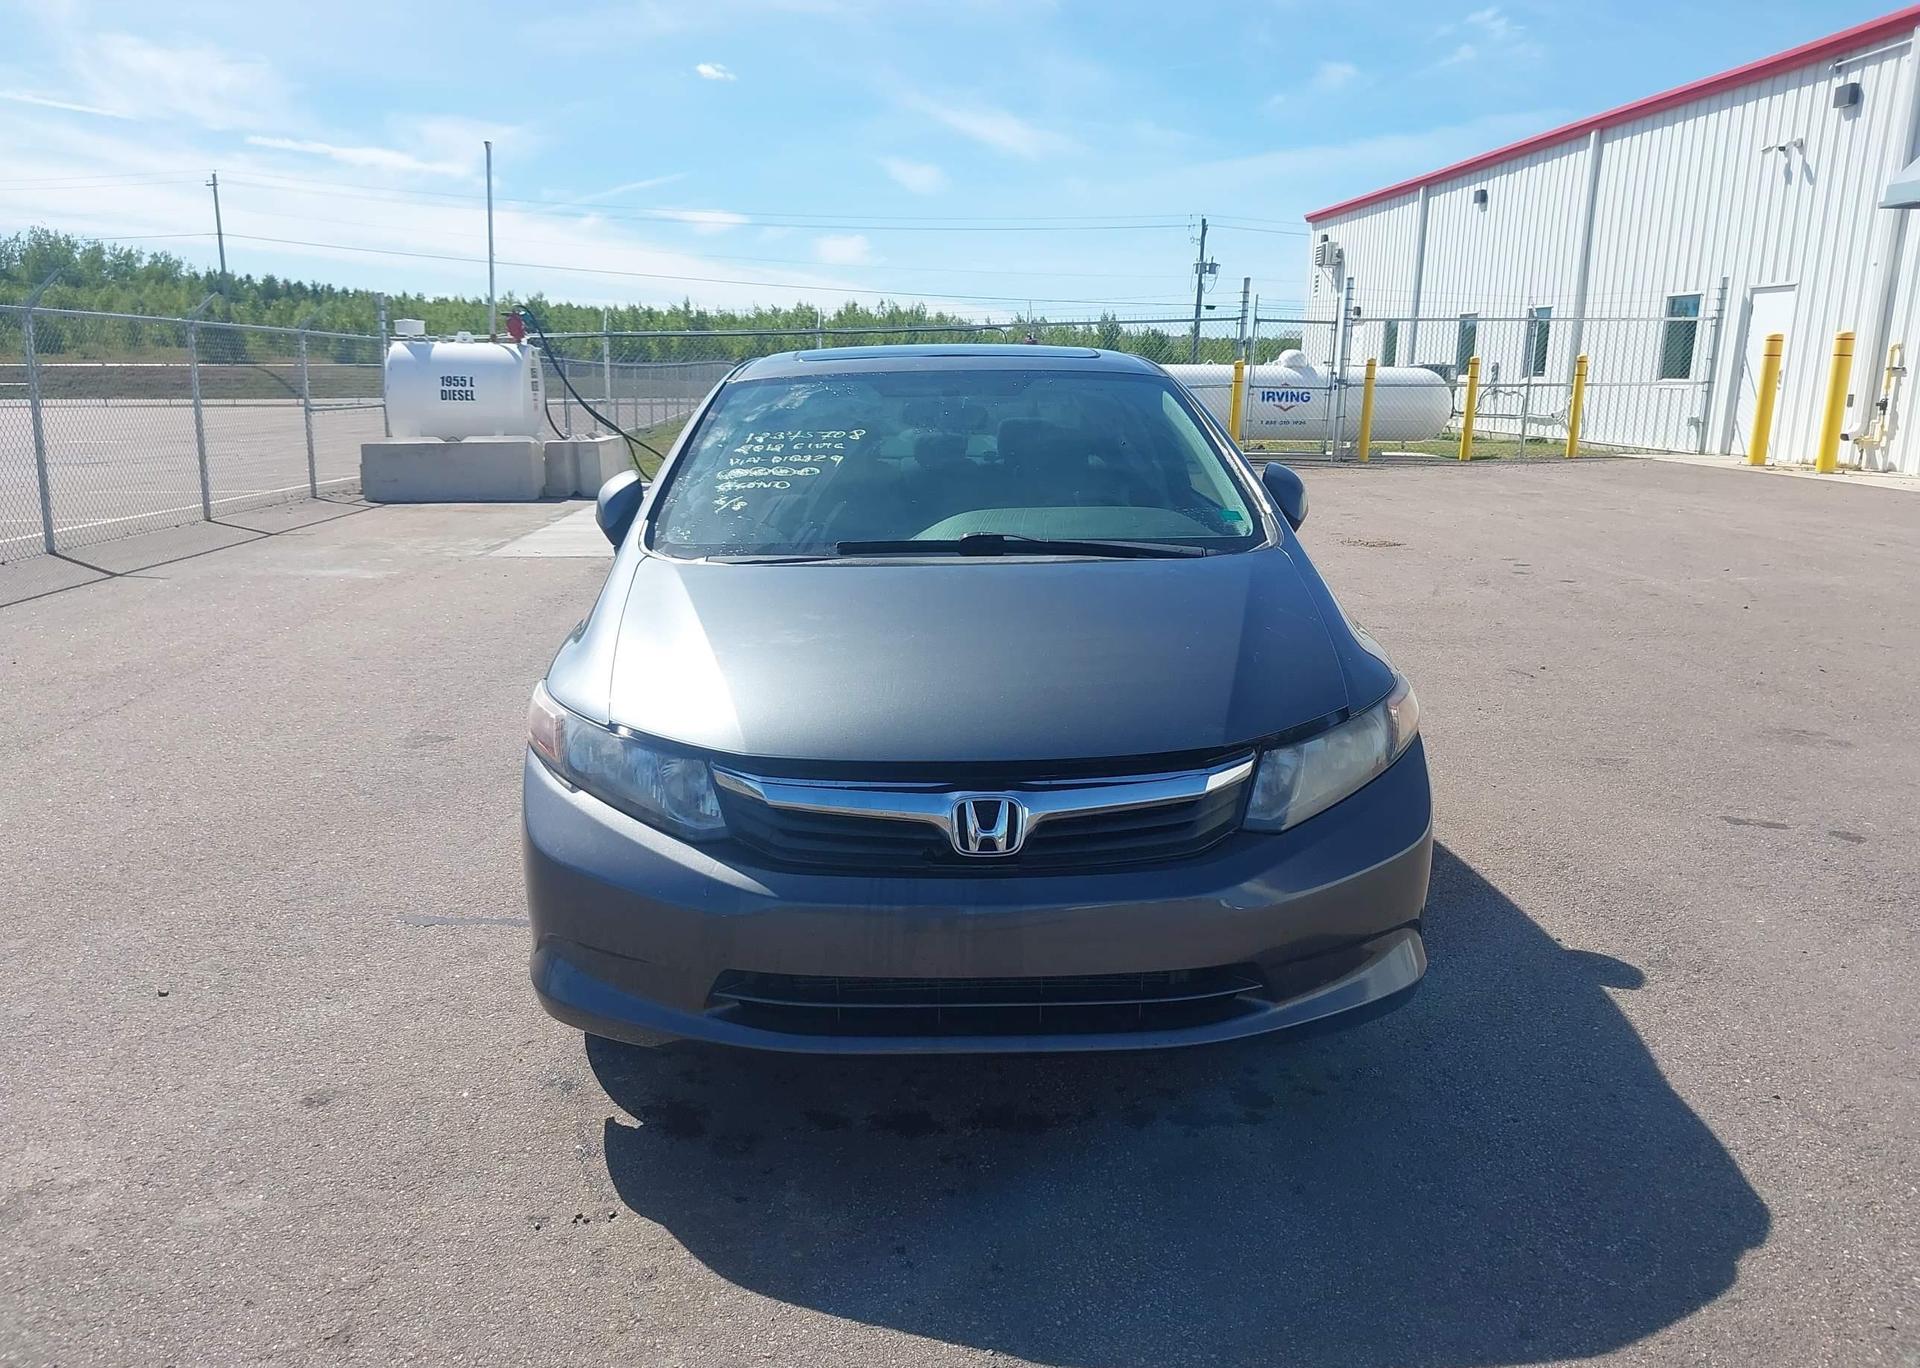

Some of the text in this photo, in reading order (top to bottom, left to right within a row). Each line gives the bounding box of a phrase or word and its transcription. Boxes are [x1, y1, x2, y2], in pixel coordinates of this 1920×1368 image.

[440, 375, 475, 387] 1955 L
[440, 389, 476, 401] DIESEL
[1261, 390, 1311, 403] IRVING
